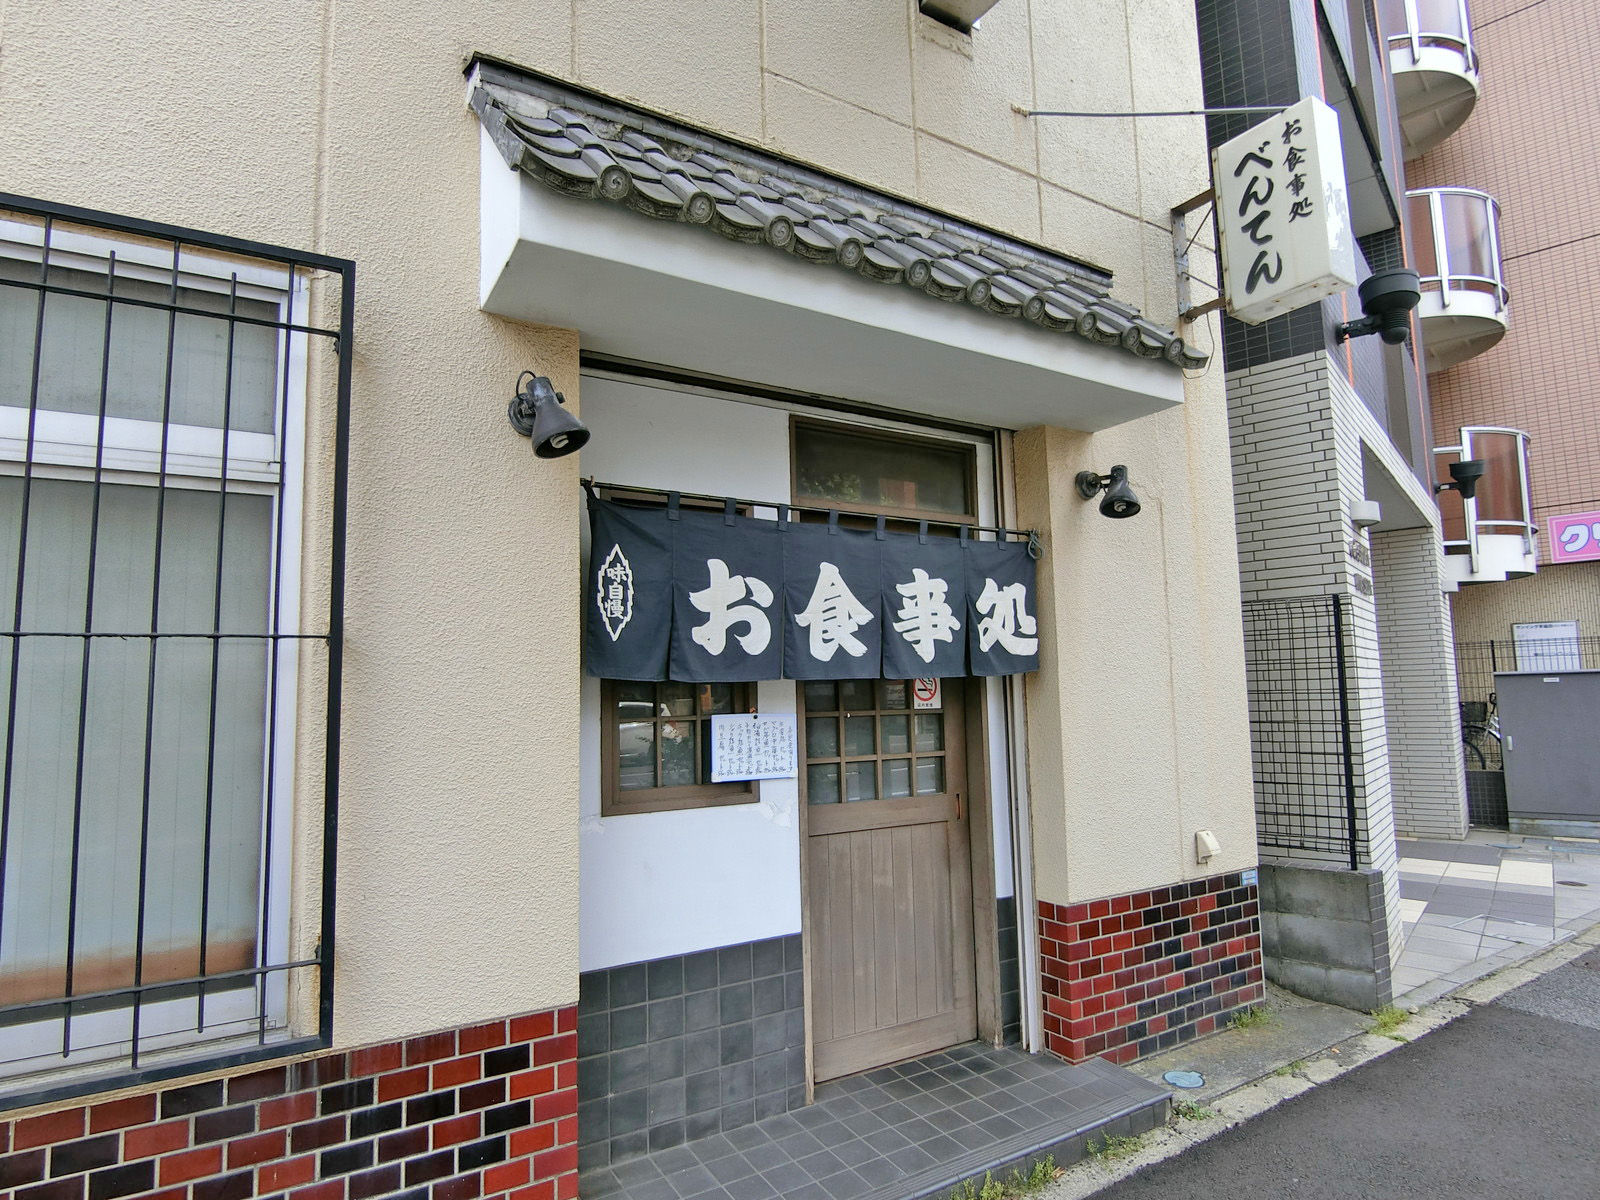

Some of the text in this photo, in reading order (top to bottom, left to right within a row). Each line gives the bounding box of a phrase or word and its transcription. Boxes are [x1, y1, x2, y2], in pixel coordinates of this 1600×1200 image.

[1234, 141, 1283, 294] べんてん
[1282, 119, 1313, 223] お食事処
[1559, 522, 1600, 553] ク
[604, 562, 629, 620] 味自慢
[688, 558, 1039, 664] お食事処
